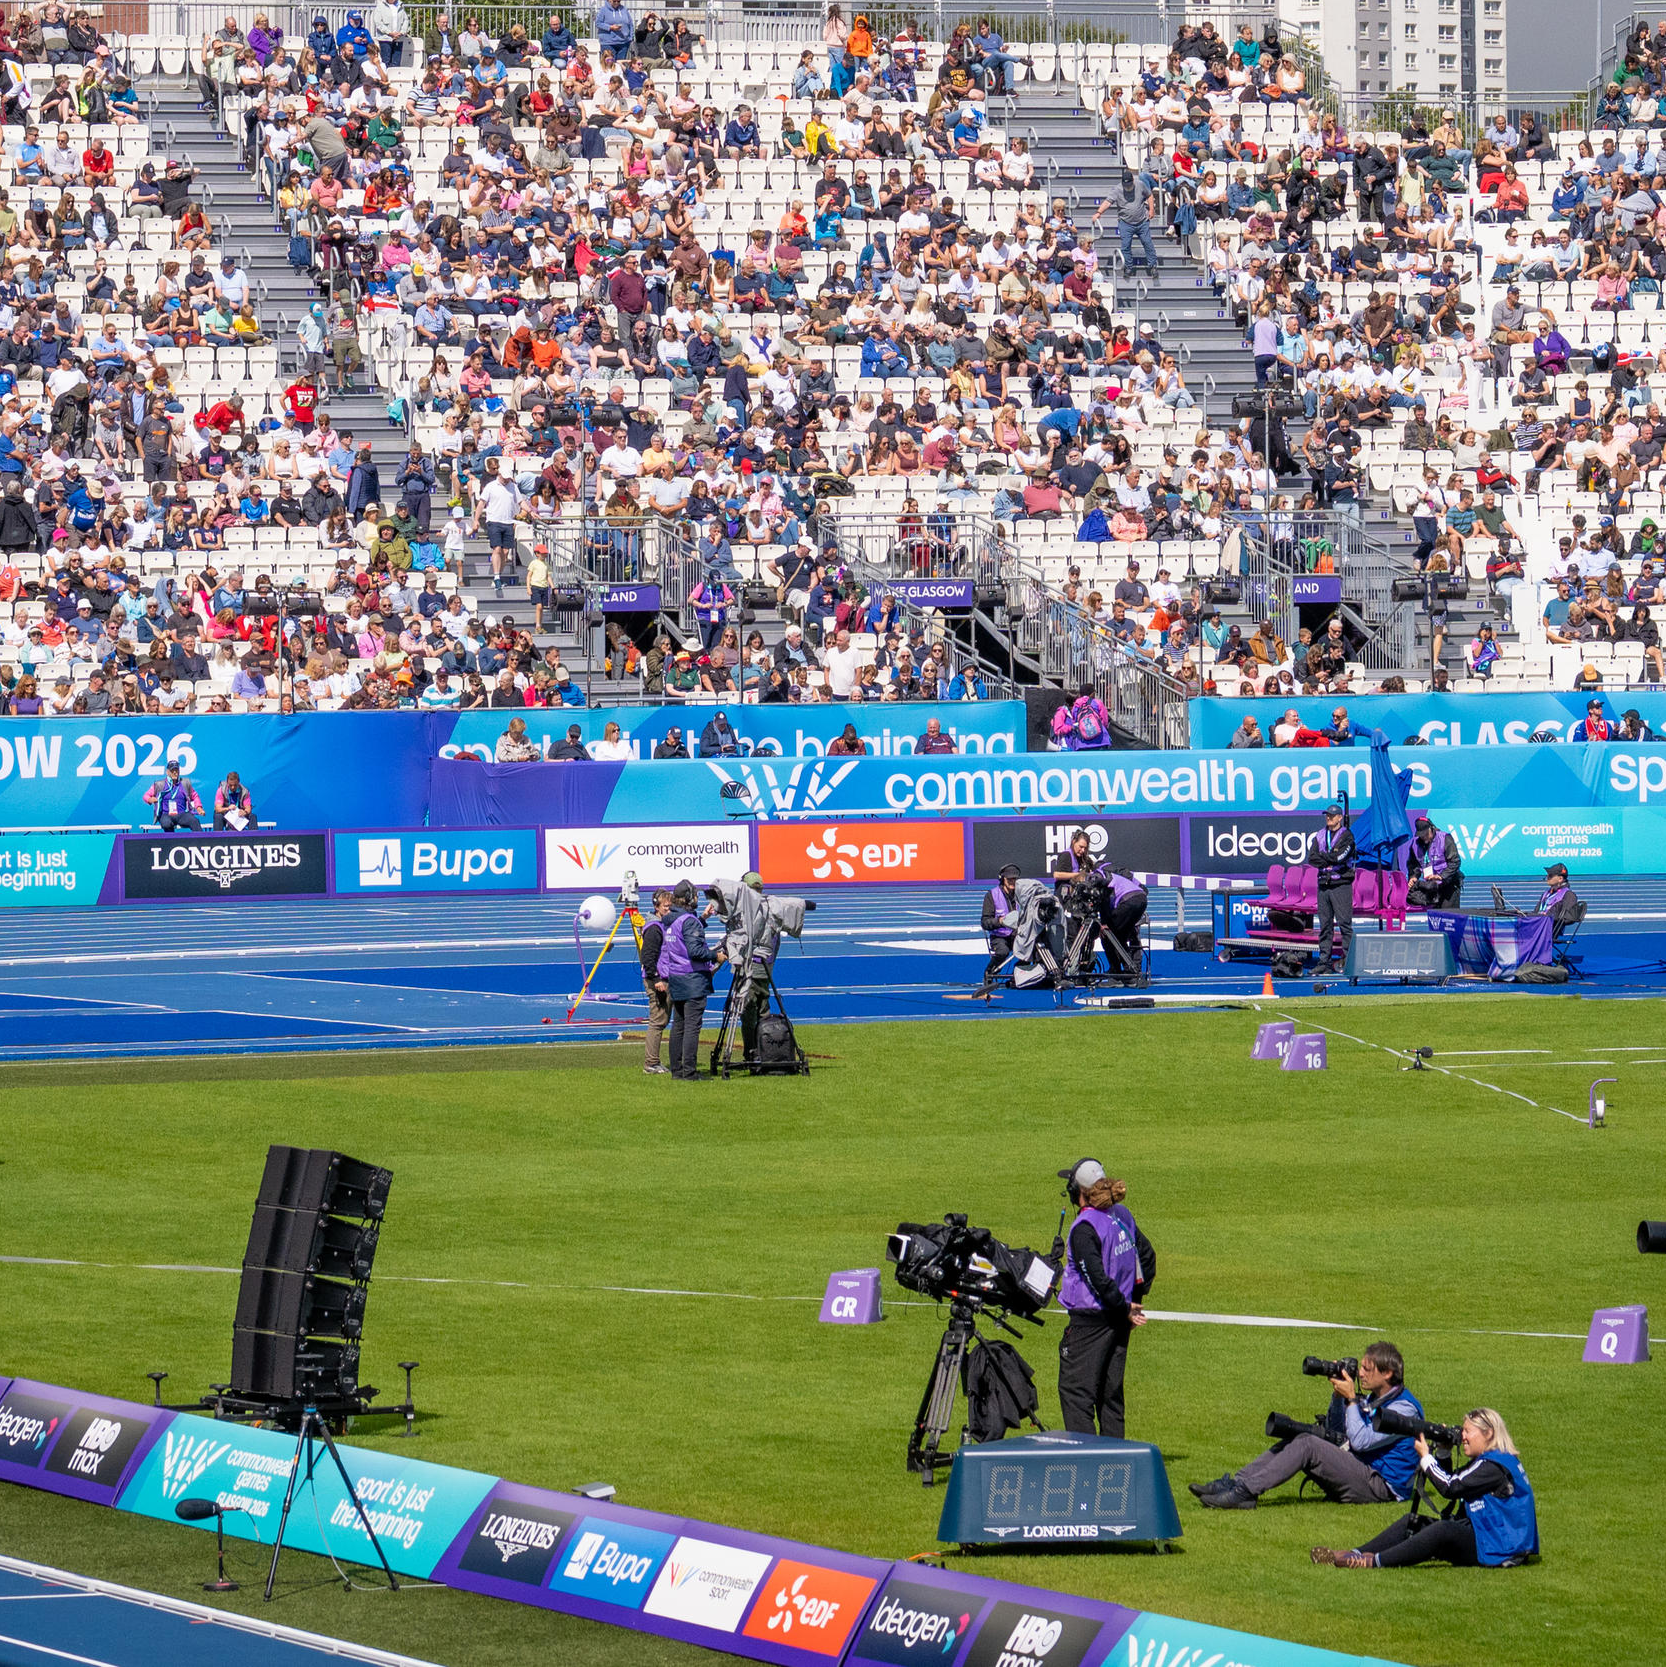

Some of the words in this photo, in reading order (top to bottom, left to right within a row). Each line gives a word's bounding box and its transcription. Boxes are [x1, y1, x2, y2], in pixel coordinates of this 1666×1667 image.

[908, 585, 966, 598] GLASGOW
[74, 733, 199, 779] 2026
[884, 760, 1255, 810] commonwealth
[1522, 821, 1614, 837] commonwealth
[1546, 833, 1589, 847] games
[150, 843, 301, 872] LONGINES
[628, 840, 740, 858] commonwealth
[1209, 825, 1318, 865] Ideag
[1533, 848, 1574, 858] GLASGOW
[1576, 847, 1603, 858] 2026
[16, 849, 32, 869] is
[33, 848, 69, 873] just
[413, 843, 514, 880] Bupa
[664, 853, 704, 872] sport
[1304, 1053, 1321, 1070] 16
[831, 1296, 857, 1318] CR
[1600, 1331, 1619, 1358] Q
[82, 1416, 122, 1453] HBO
[69, 1447, 105, 1476] max
[234, 1469, 271, 1493] games
[216, 1493, 250, 1514] GLASGOW
[249, 1496, 271, 1518] 2026
[353, 1476, 394, 1507] sport
[393, 1478, 410, 1504] is
[403, 1484, 435, 1513] just
[330, 1501, 357, 1527] the
[482, 1512, 560, 1550] LONGINES
[1023, 1525, 1099, 1538] LONGINES
[592, 1541, 653, 1586] Bupa
[698, 1570, 754, 1592] commonwealth
[709, 1585, 731, 1601] sport
[869, 1595, 948, 1644] Ideagen
[1006, 1613, 1063, 1657] HBO
